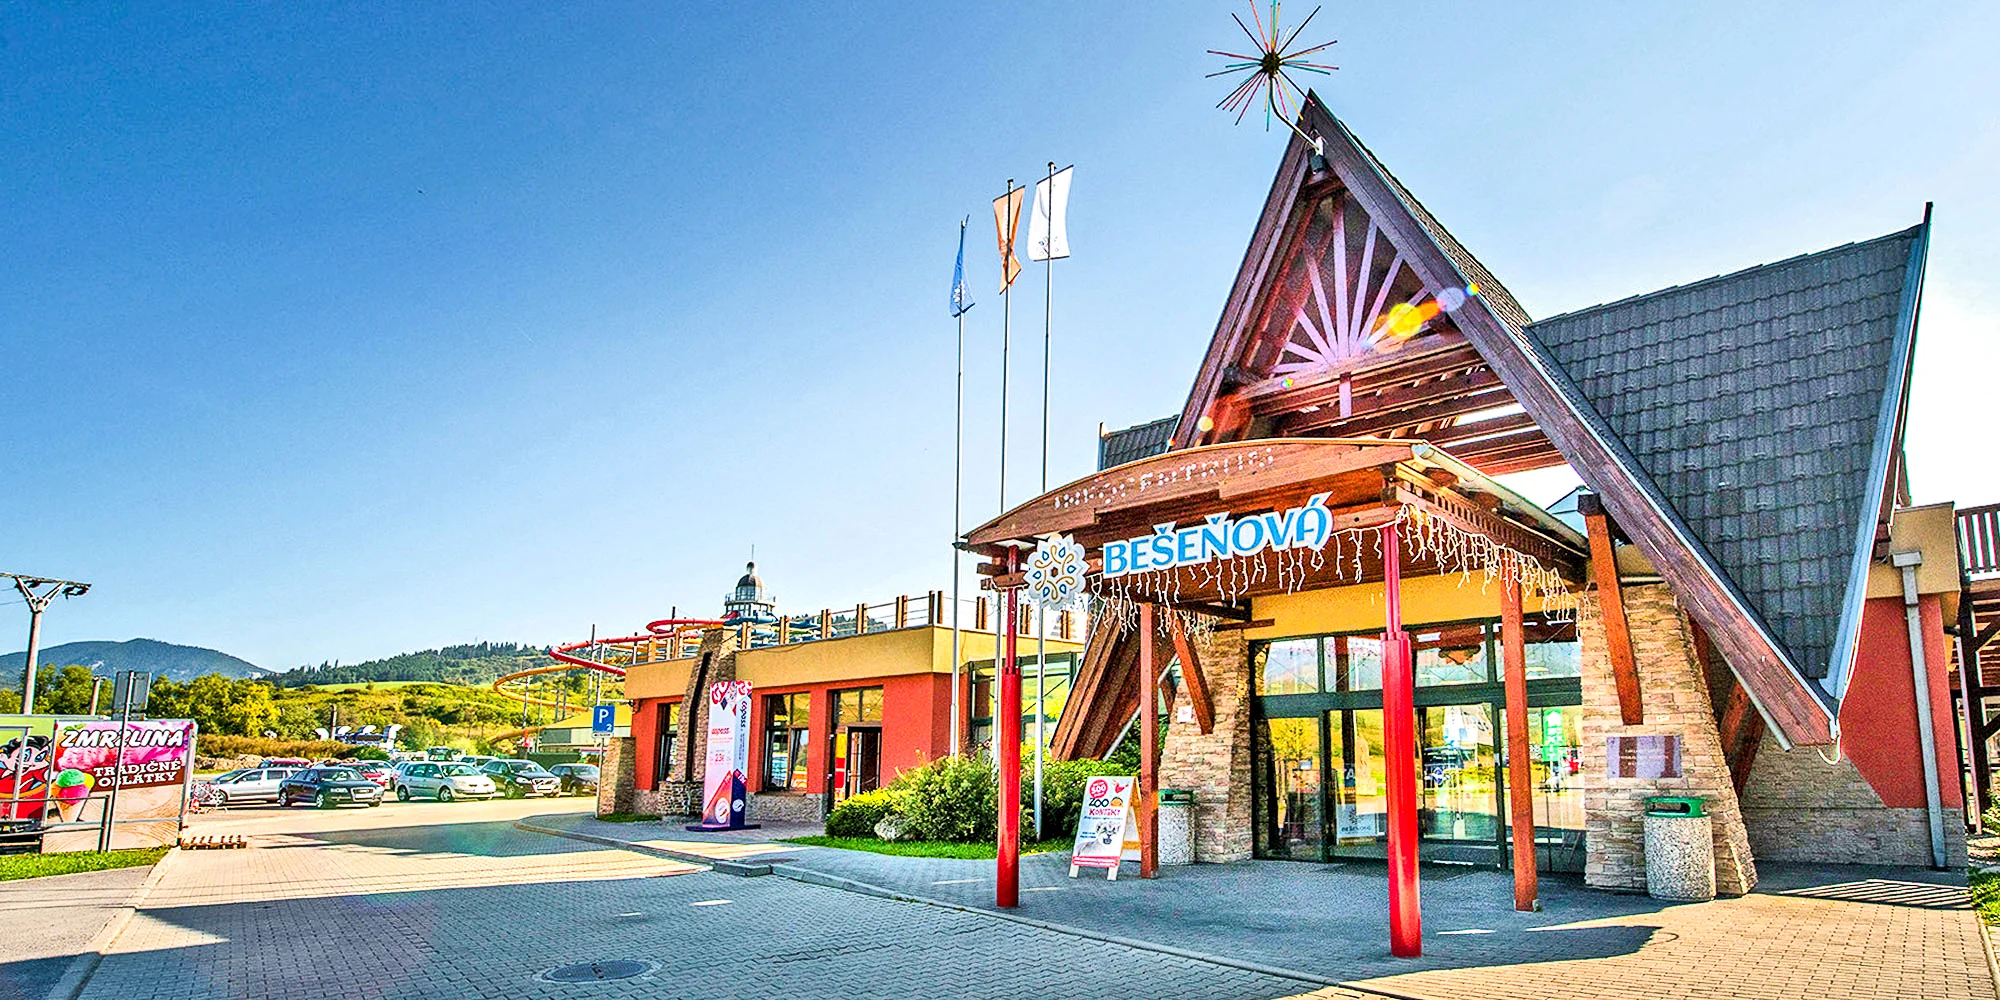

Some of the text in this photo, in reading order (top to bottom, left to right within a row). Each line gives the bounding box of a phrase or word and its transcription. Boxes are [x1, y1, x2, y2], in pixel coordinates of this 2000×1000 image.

[1104, 495, 1331, 577] BEŠEŇOVÁ
[598, 708, 609, 724] P
[94, 757, 181, 778] TRADIČNÉ
[1088, 797, 1110, 808] ZOO
